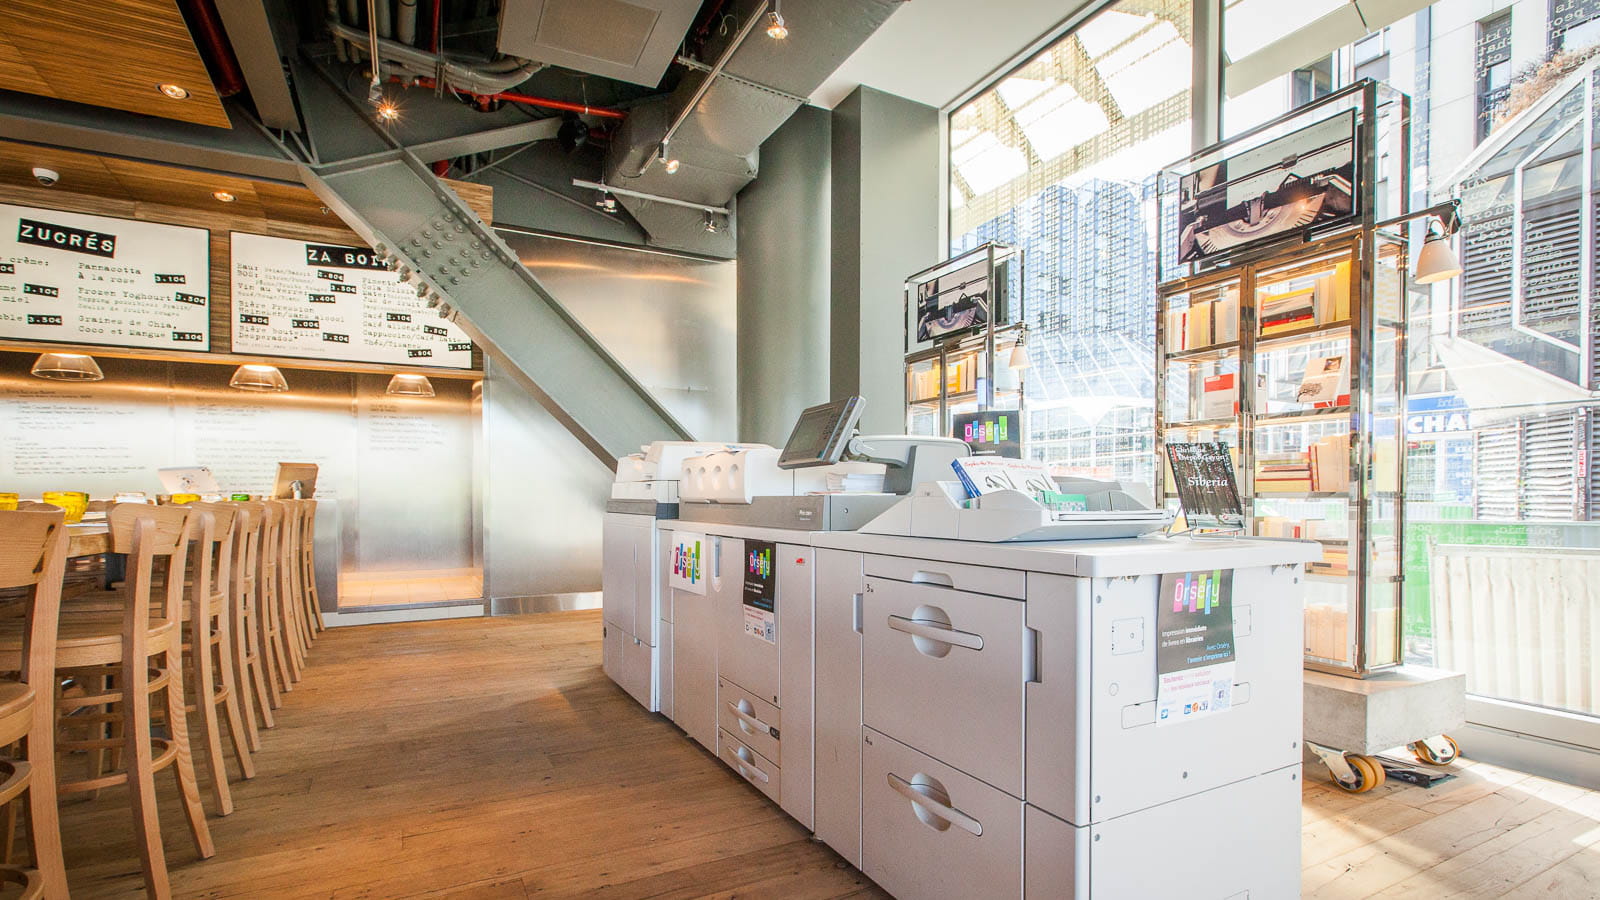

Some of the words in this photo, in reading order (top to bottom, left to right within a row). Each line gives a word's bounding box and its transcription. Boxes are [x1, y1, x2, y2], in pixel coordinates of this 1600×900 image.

[20, 223, 114, 252] ZUCRÉS
[308, 249, 331, 262] ZA
[78, 262, 141, 274] Pannacotta
[78, 287, 117, 297] Frozen
[122, 291, 171, 302] Yoghourt
[78, 315, 123, 325] Graines
[78, 326, 104, 334] Coco
[129, 329, 166, 339] Mangue
[1408, 413, 1472, 433] CHA
[1188, 476, 1228, 488] Siberia
